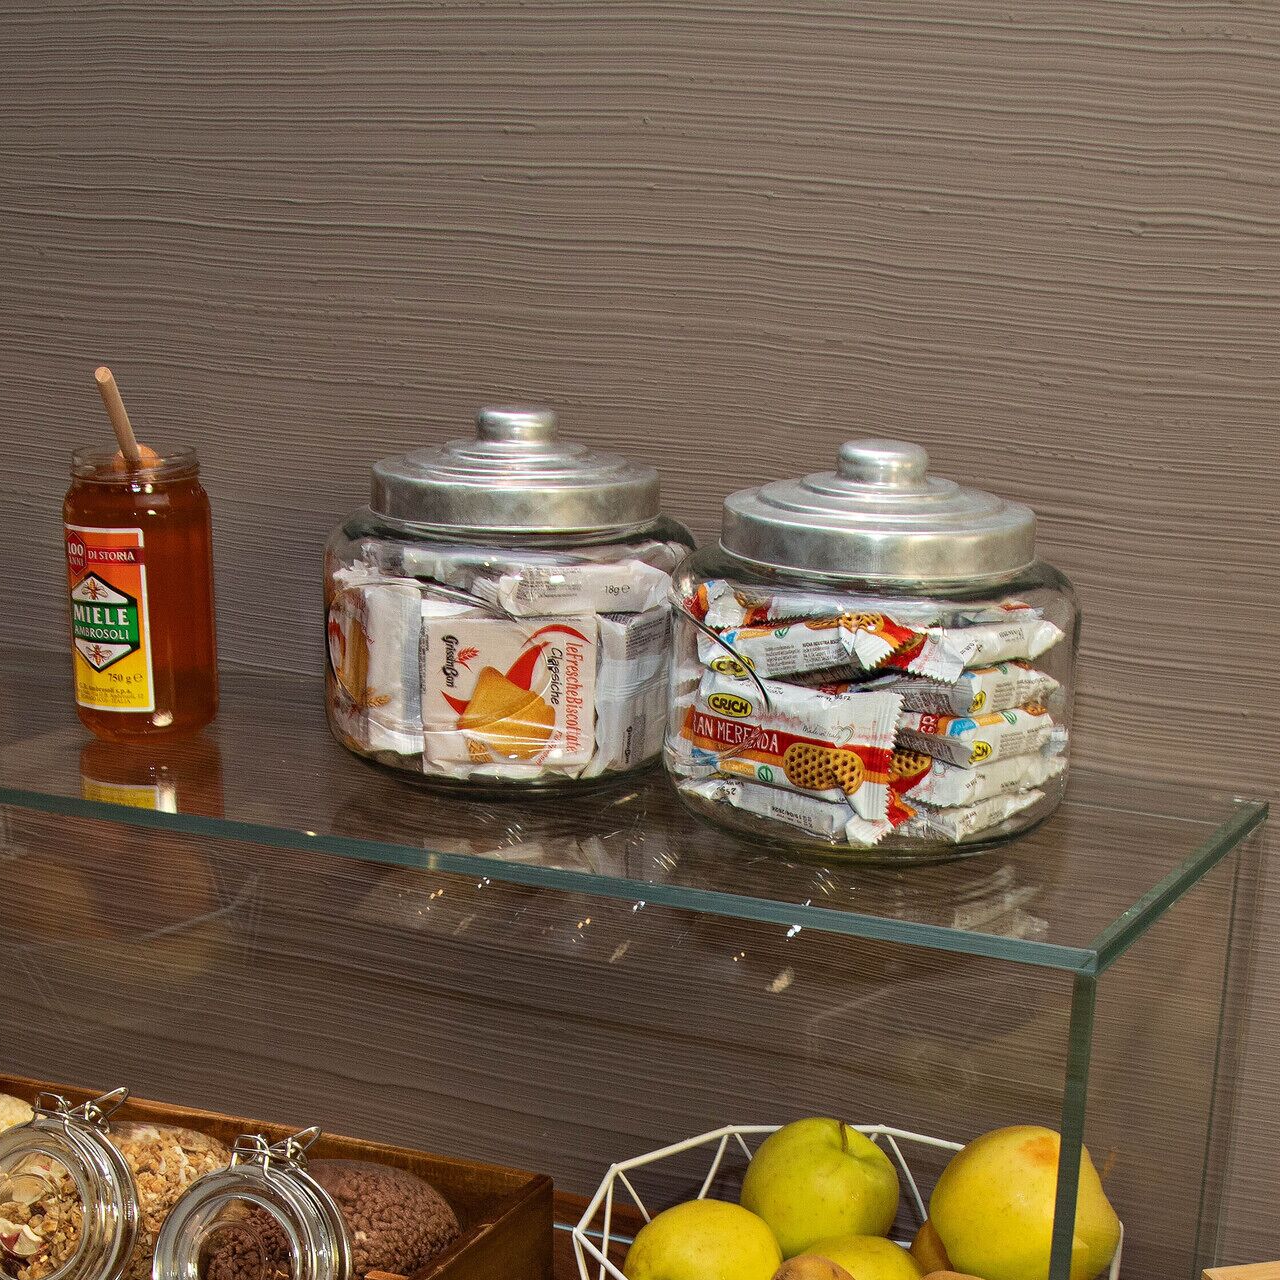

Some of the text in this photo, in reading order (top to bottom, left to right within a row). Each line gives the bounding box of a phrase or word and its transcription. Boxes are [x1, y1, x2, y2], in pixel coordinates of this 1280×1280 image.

[88, 551, 135, 561] DI STORIA
[604, 585, 619, 596] 18g
[74, 604, 130, 626] MIELE
[74, 625, 129, 640] AMBROSOLI
[108, 673, 123, 682] 750
[550, 647, 564, 705] Classiche
[712, 696, 749, 714] CRICH
